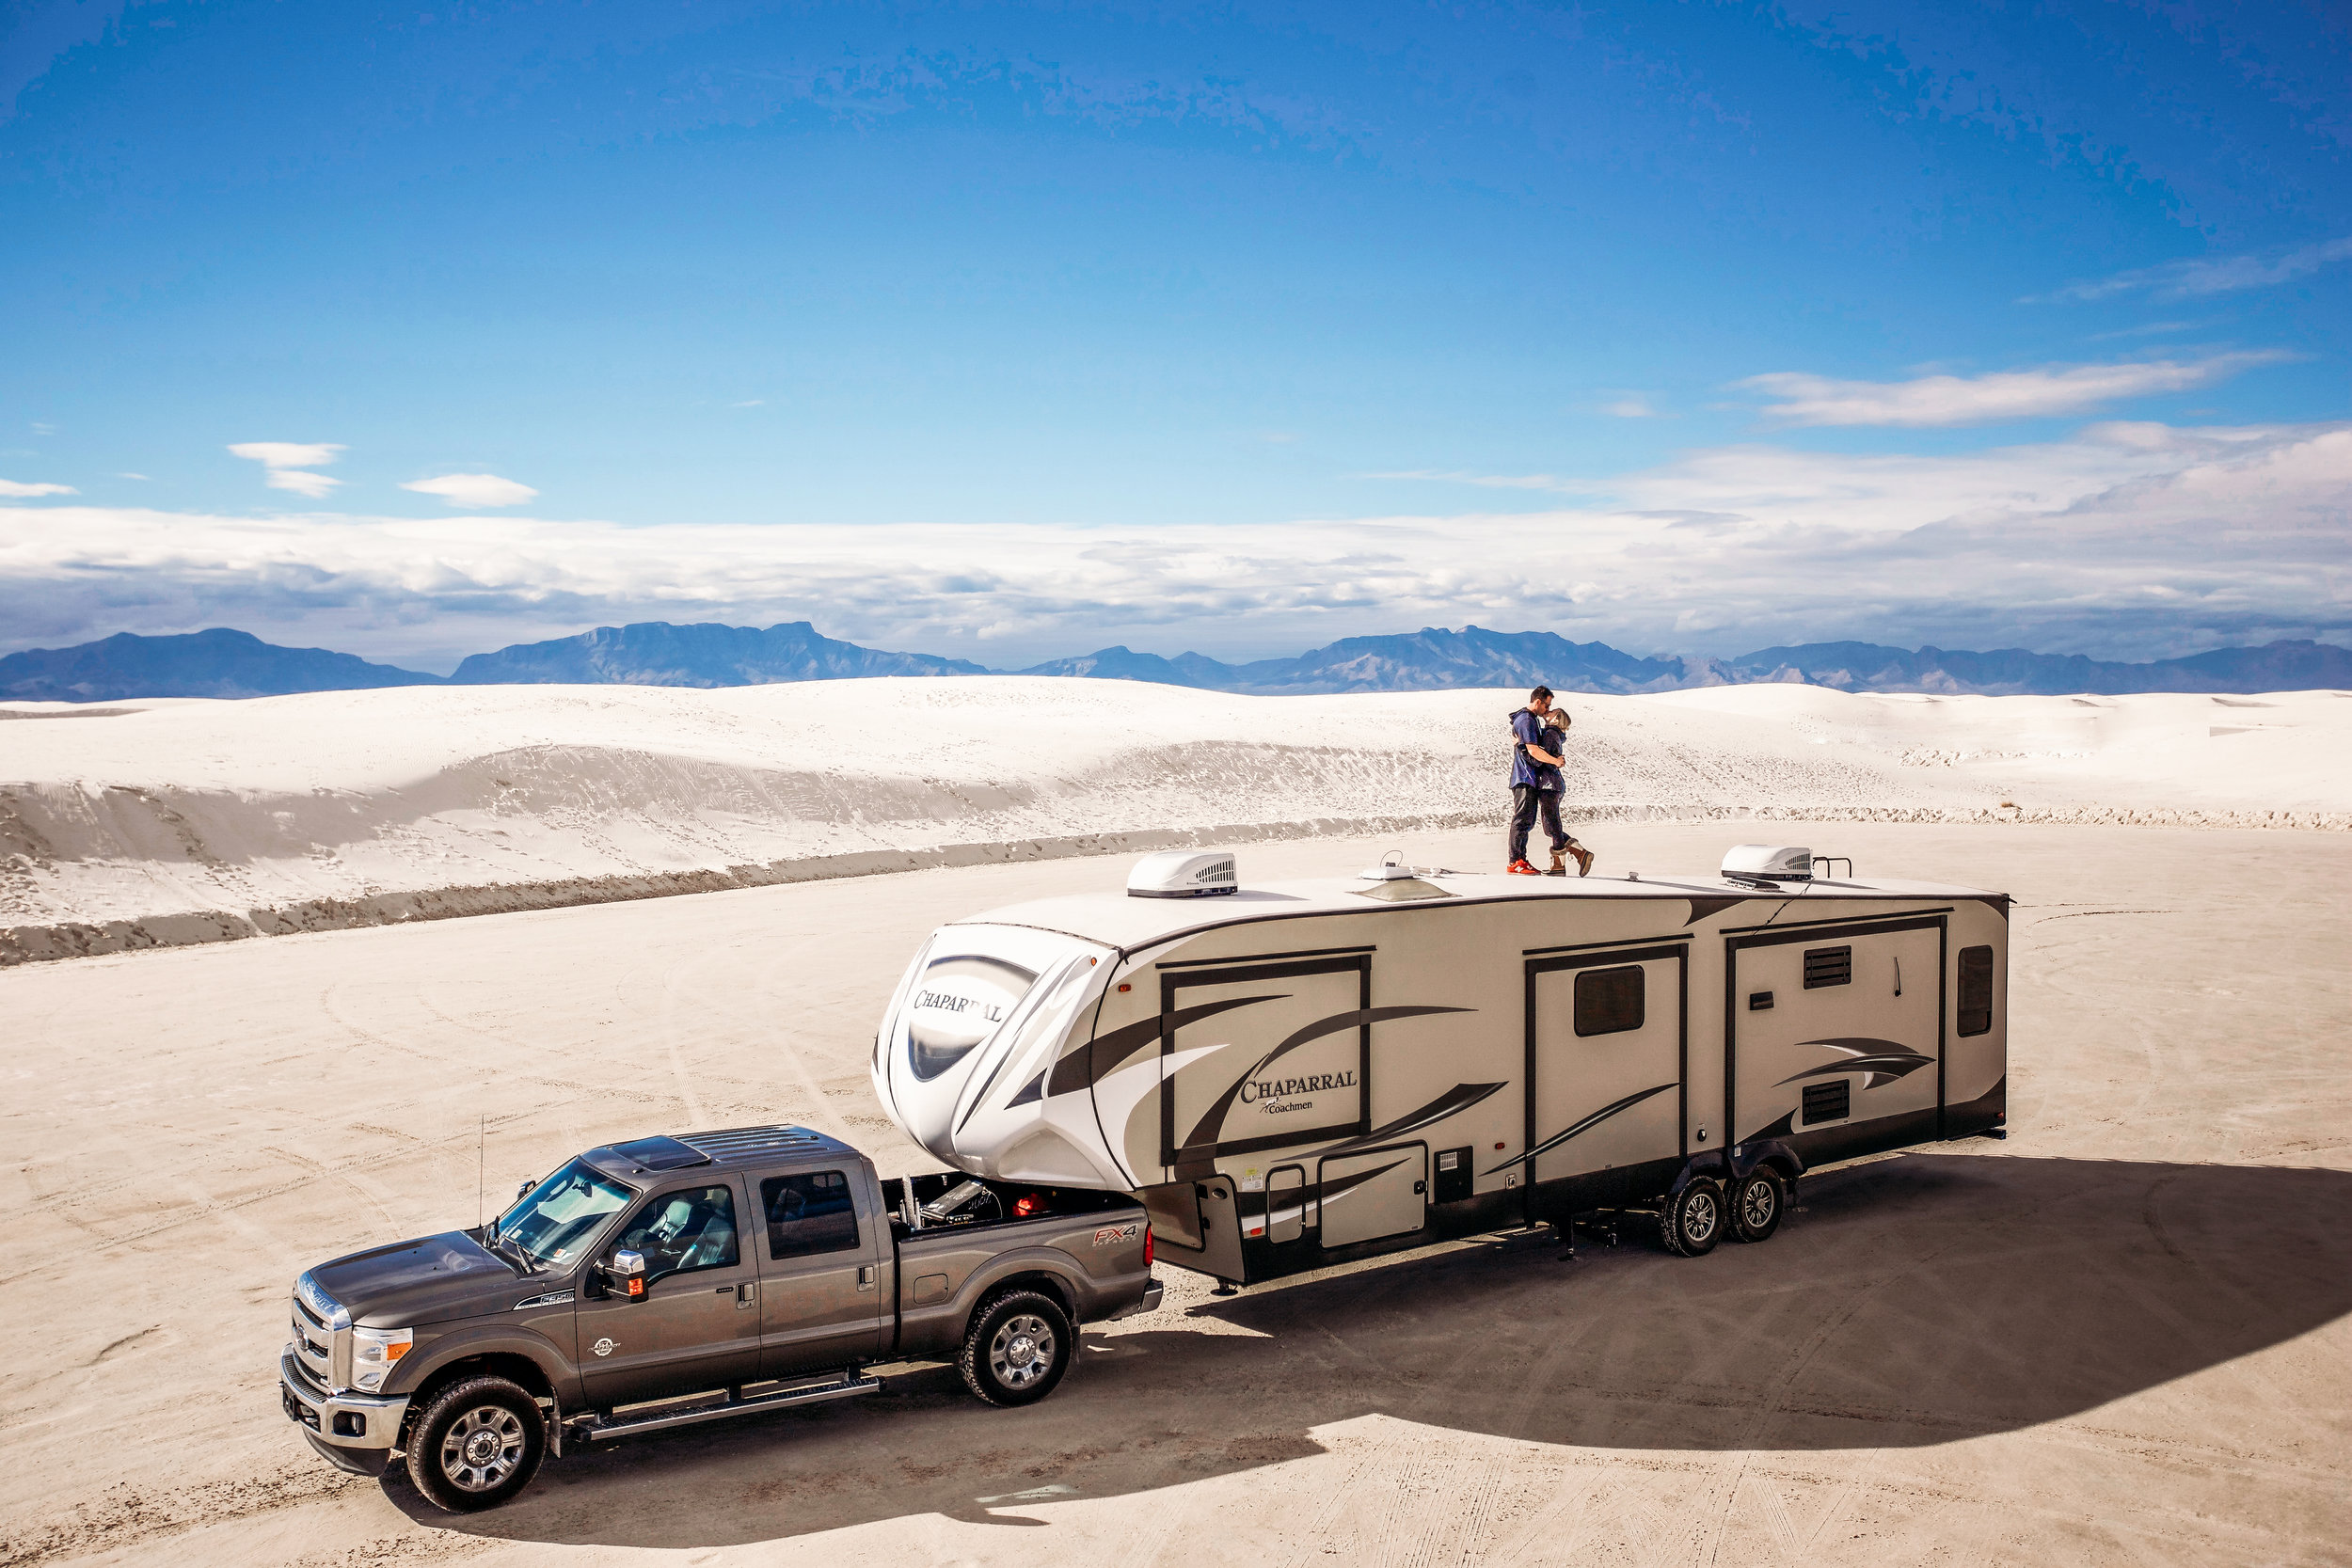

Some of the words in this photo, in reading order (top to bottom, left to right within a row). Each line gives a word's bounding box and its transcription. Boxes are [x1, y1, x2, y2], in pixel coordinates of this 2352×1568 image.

[1241, 1070, 1358, 1103] CHAPARRAL
[1268, 1101, 1312, 1115] Coachmen
[1093, 1224, 1138, 1243] FX4
